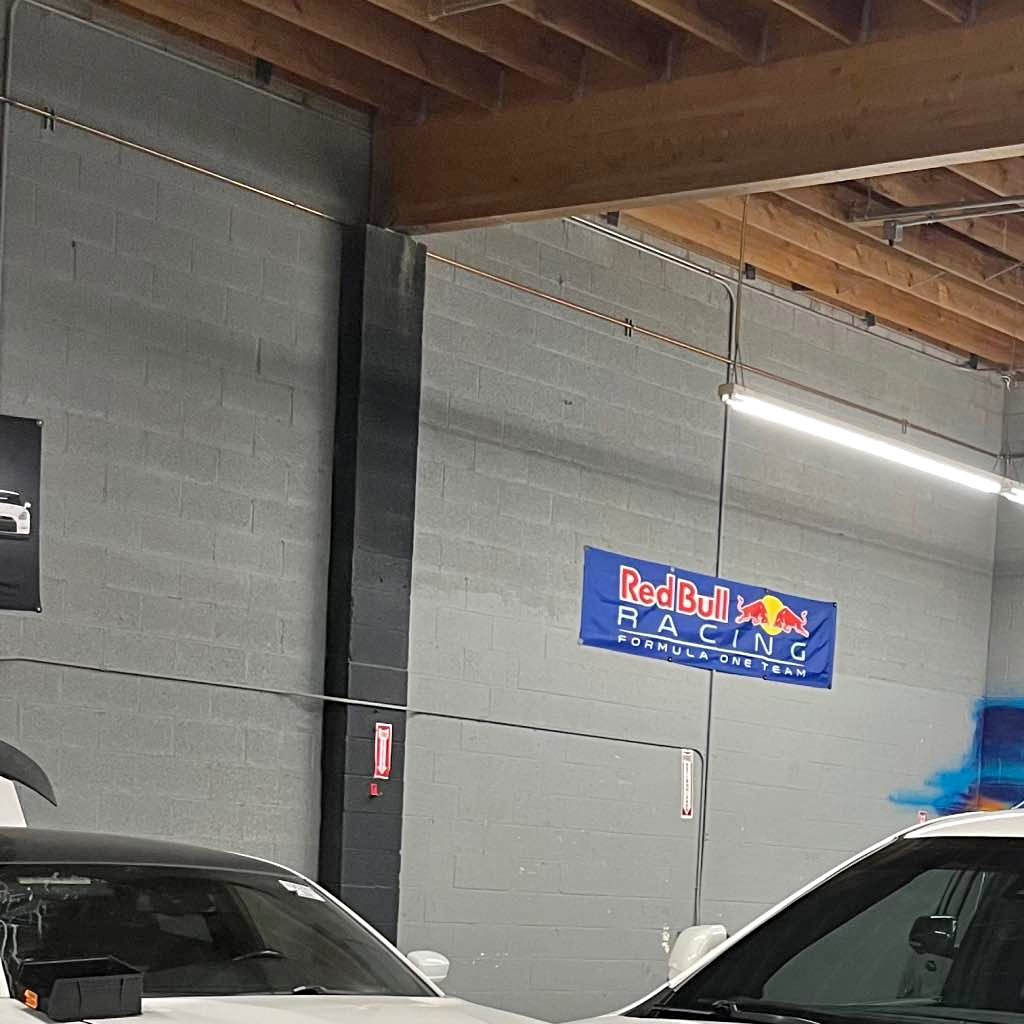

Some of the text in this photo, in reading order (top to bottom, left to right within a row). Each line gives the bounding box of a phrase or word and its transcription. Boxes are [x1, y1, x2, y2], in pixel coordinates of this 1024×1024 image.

[617, 605, 807, 662] RACING
[617, 634, 807, 678] FORMULA ONE TEAM
